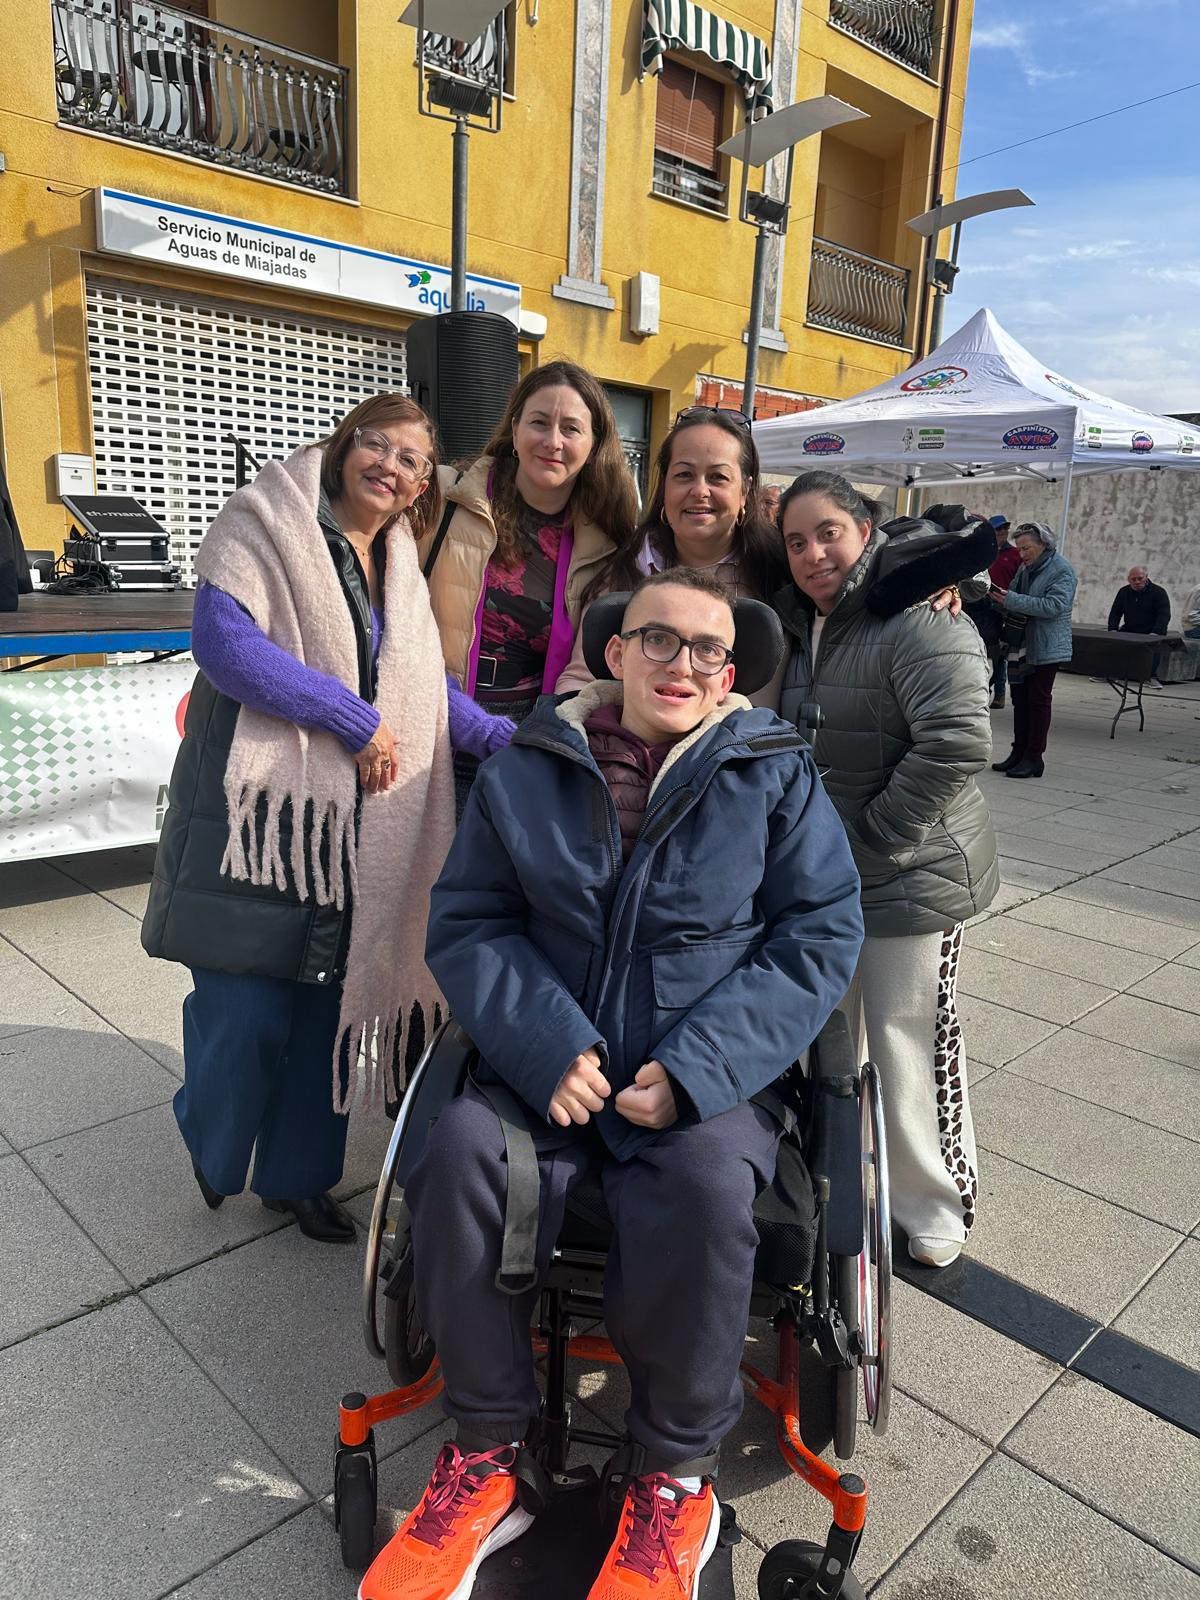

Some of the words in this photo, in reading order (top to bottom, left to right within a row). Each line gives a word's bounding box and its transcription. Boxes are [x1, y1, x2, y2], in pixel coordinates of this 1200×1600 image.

[158, 216, 222, 243] Servicio
[227, 231, 296, 259] Municipal
[299, 249, 317, 263] de
[168, 238, 218, 261] Aguas
[222, 251, 240, 265] de
[245, 254, 307, 279] Miajadas
[418, 287, 486, 313] aqulia
[806, 441, 841, 452] AVIS
[1007, 434, 1052, 446] AVIS
